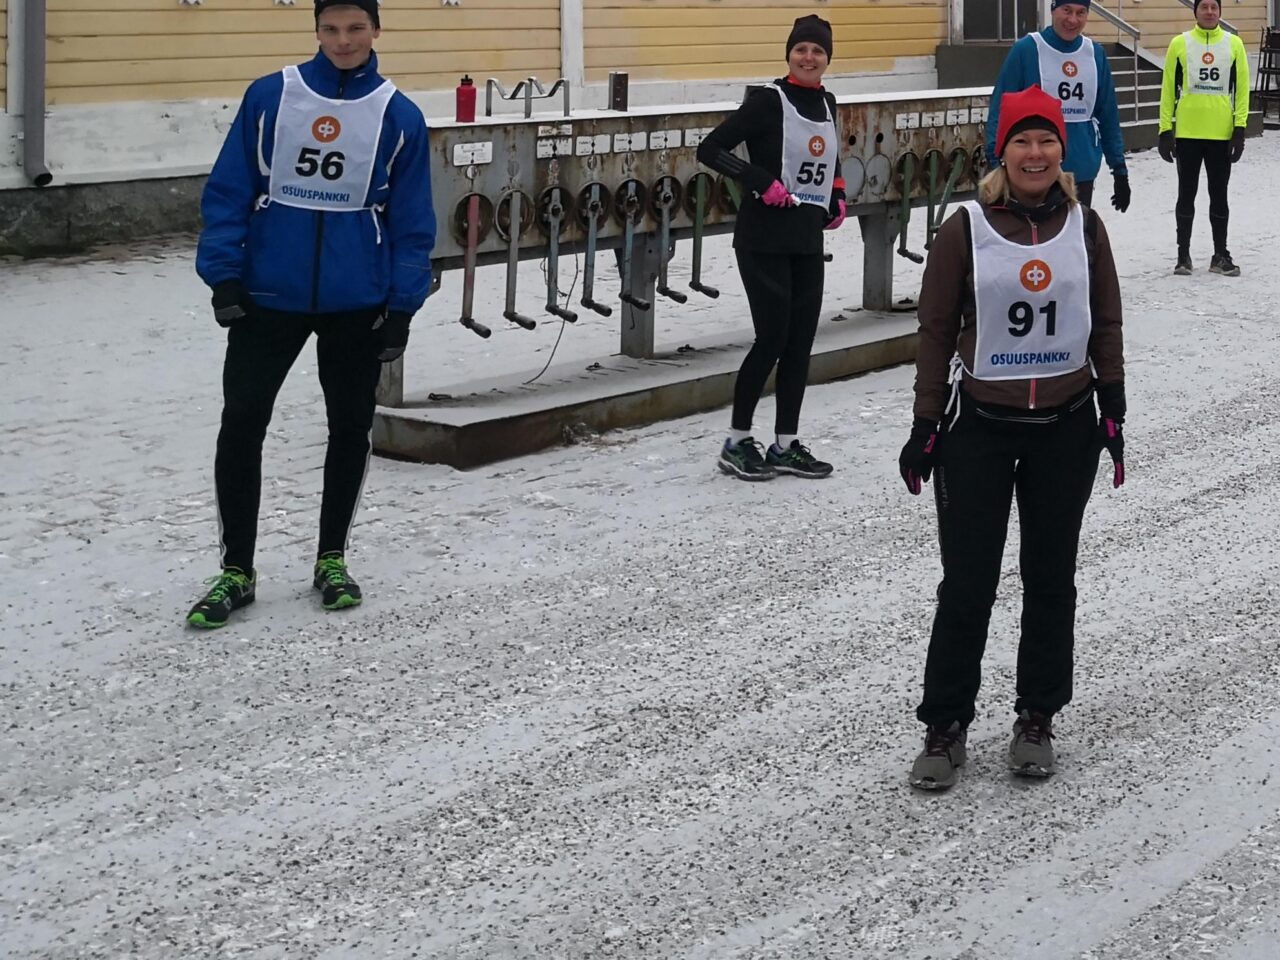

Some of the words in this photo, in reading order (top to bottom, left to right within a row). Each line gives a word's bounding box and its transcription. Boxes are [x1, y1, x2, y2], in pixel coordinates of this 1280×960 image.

[1199, 67, 1220, 81] 56
[1058, 82, 1084, 100] 64
[295, 147, 345, 180] 56
[797, 161, 827, 186] 55
[282, 185, 350, 202] OSUUSPANKKI
[1008, 300, 1056, 337] 91
[991, 352, 1070, 365] OSUUSPANKKI
